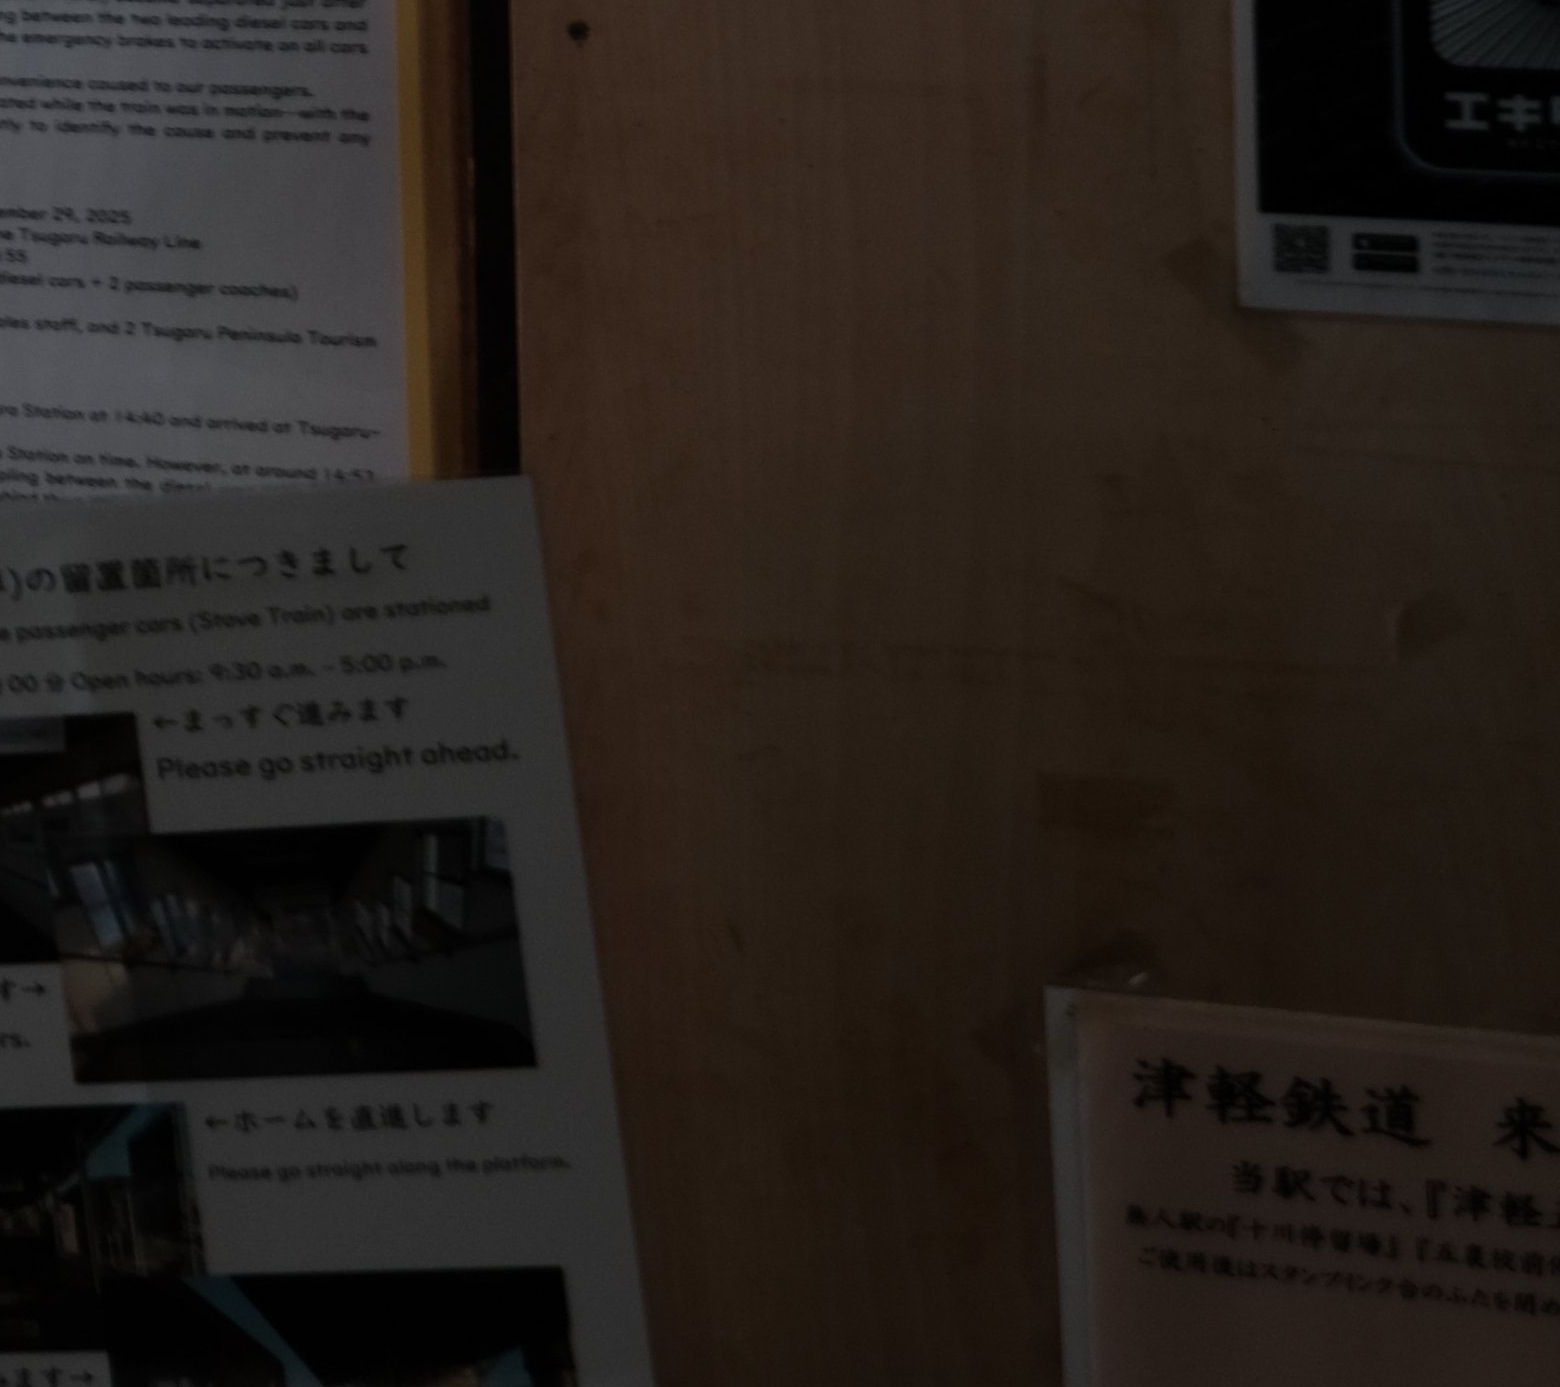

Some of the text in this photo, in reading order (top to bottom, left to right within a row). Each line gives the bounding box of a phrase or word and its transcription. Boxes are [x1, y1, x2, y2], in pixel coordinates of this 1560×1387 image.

[156, 740, 520, 783] Please go straight ahead.
[1132, 1057, 1431, 1147] 津軽鉄道
